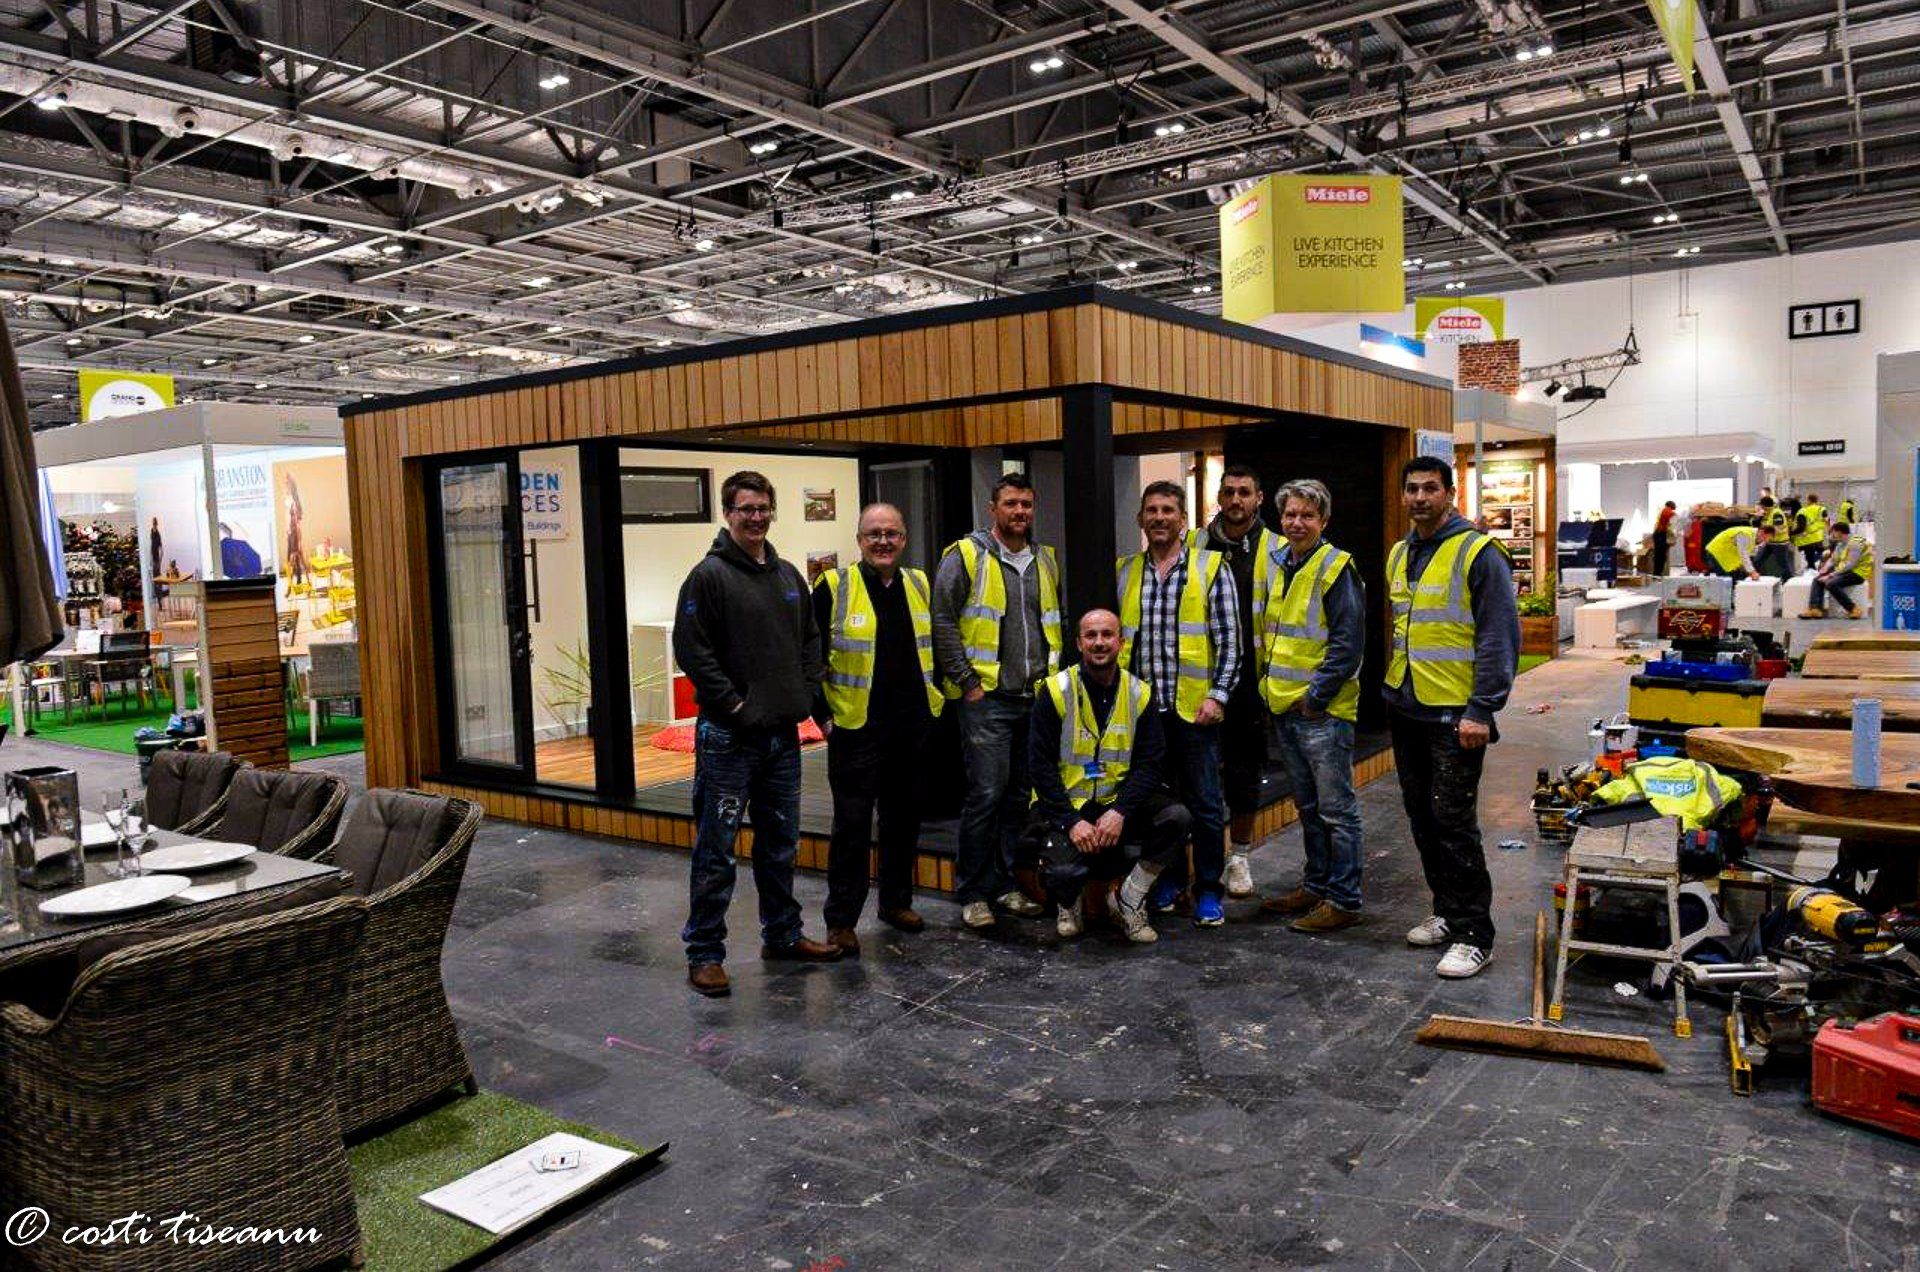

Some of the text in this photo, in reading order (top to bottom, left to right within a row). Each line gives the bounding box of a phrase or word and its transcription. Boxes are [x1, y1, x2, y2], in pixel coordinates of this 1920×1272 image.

[1306, 187, 1369, 201] Miele
[1293, 237, 1384, 251] LIVE KITCHEN
[1298, 254, 1378, 268] EXPERIENCE
[1439, 317, 1481, 328] Miele
[527, 521, 561, 532] Buildings
